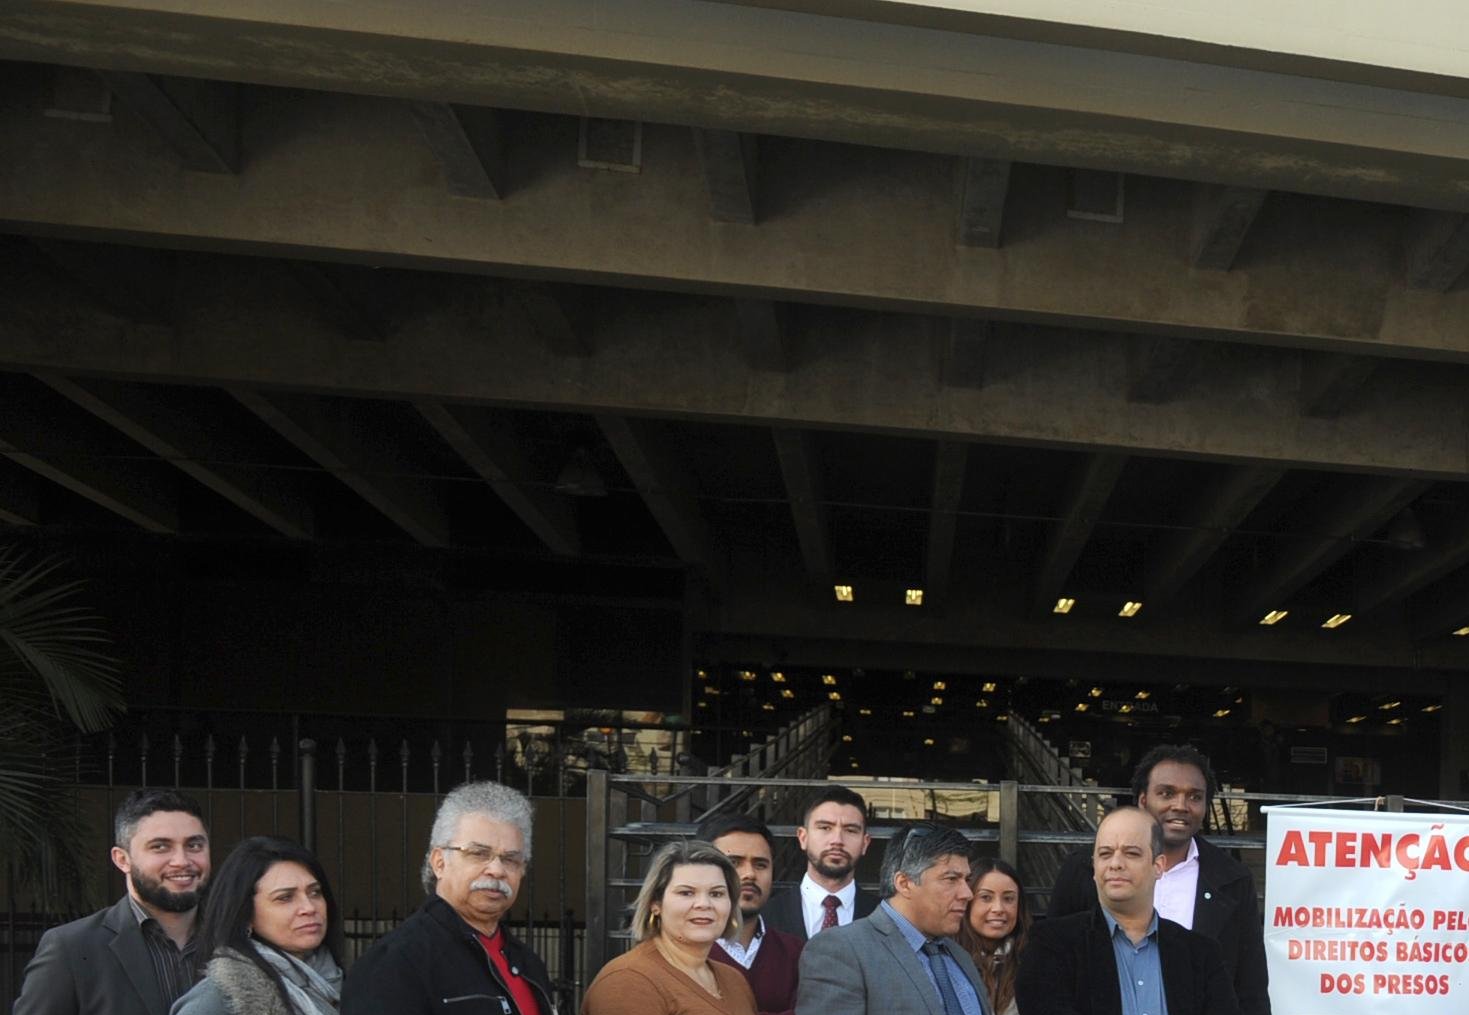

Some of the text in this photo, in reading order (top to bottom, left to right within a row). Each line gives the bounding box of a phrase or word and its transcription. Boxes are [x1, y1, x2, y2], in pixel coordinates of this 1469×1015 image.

[1273, 903, 1425, 936] MOBILIZAÇÃO
[1287, 939, 1389, 962] DIREITOS
[1320, 973, 1450, 995] DOS PRESOS
